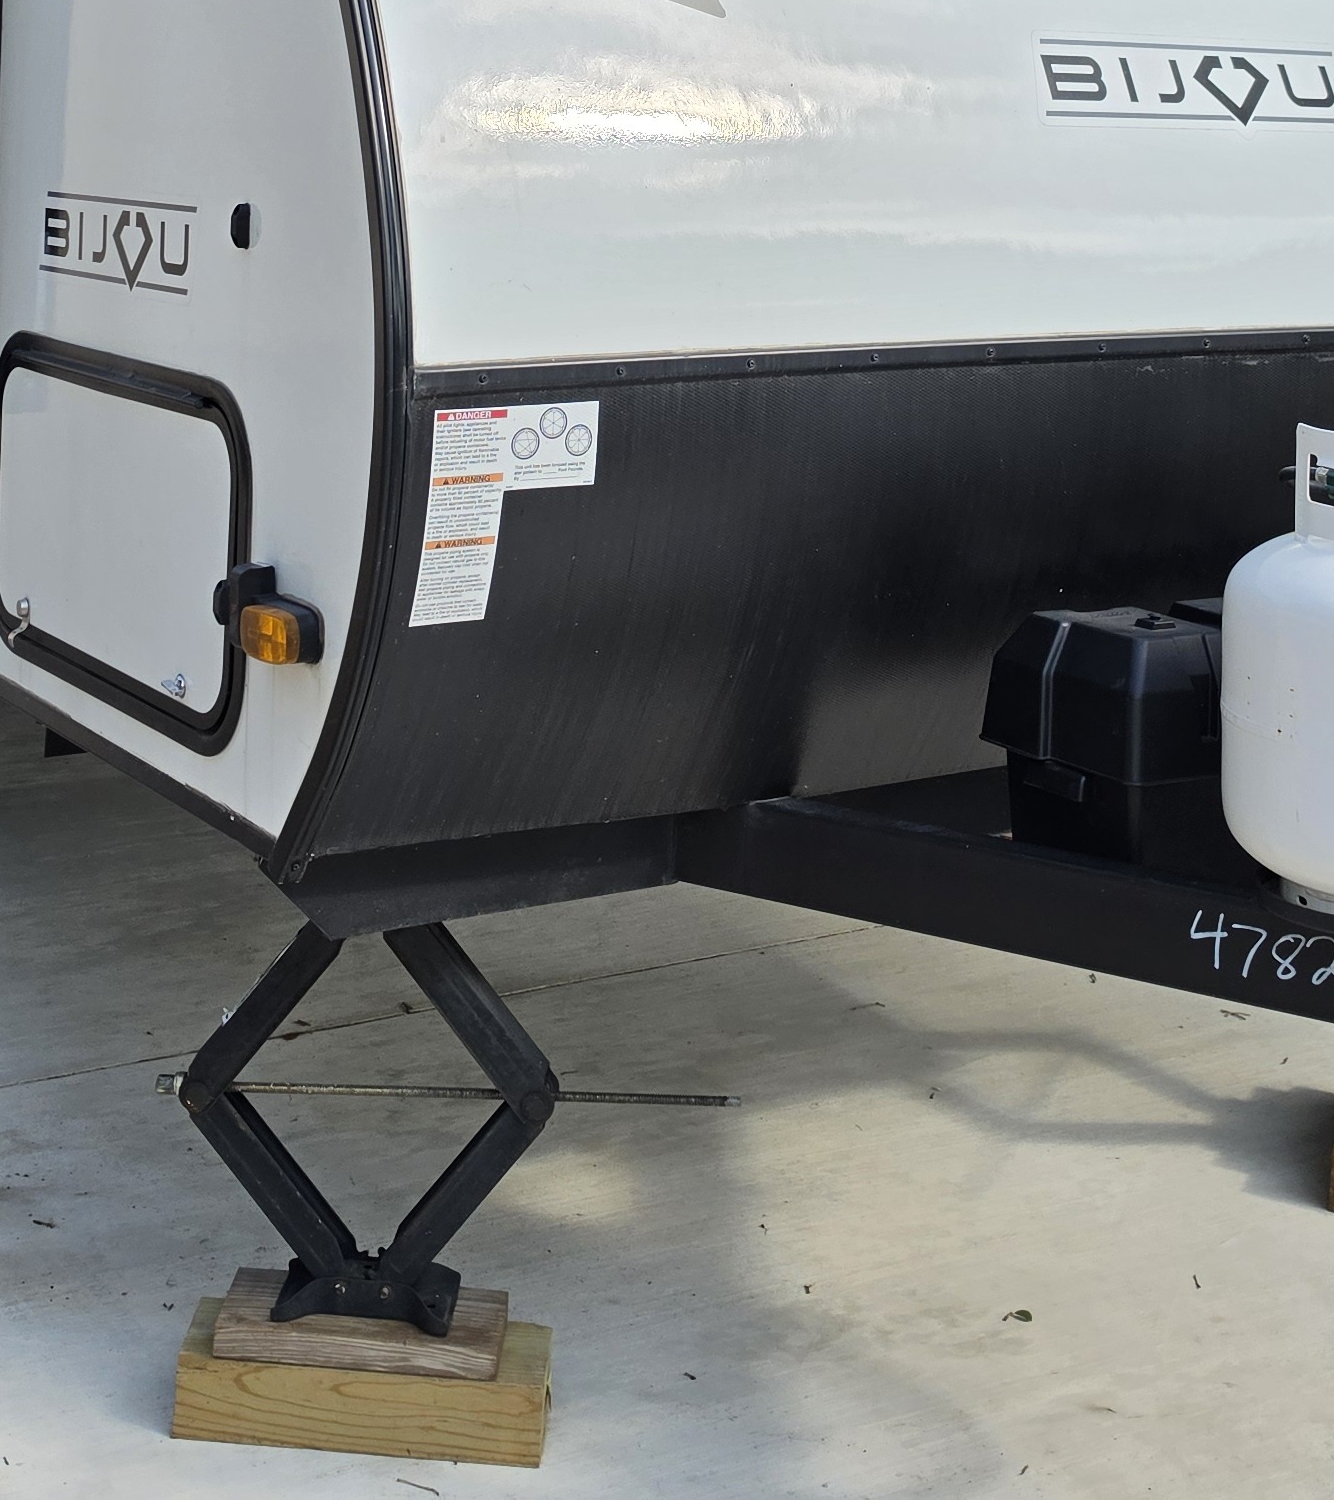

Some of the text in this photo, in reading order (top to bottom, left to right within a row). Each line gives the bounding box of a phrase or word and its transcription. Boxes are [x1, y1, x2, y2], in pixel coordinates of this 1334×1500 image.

[1040, 54, 1334, 126] BIJOU
[43, 207, 190, 292] BIJOU
[455, 410, 492, 421] DANGER
[451, 474, 491, 485] WARNING
[444, 537, 483, 548] WARNING
